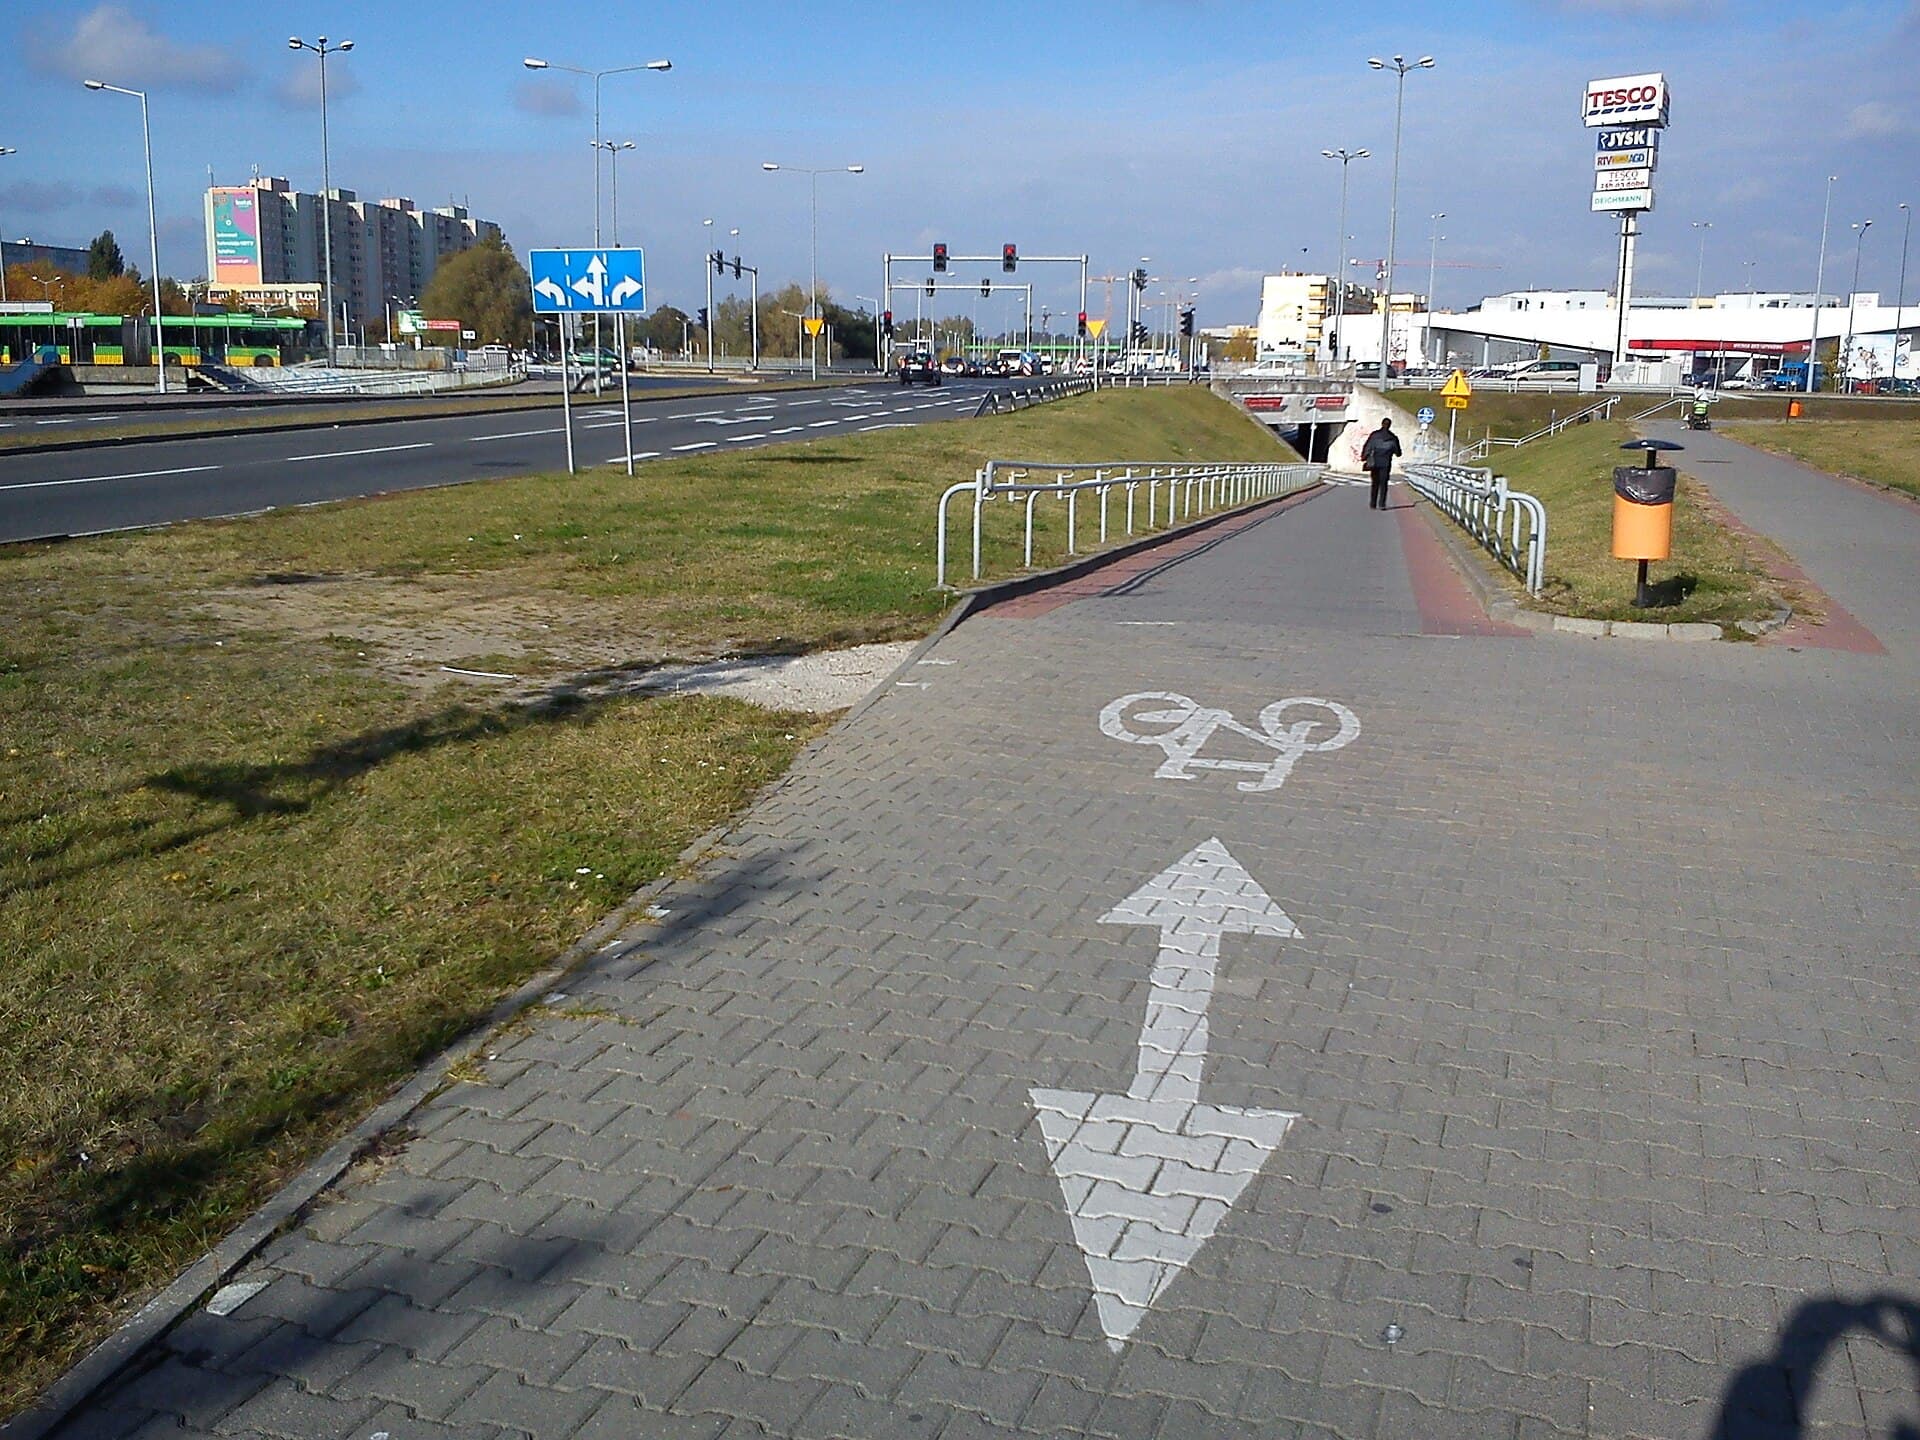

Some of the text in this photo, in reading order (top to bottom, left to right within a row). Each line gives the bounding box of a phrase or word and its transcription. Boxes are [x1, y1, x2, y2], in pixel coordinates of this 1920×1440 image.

[1588, 86, 1657, 107] TESCO
[1607, 130, 1646, 147] JYSK
[1609, 170, 1639, 179] TESCO
[1595, 195, 1642, 205] DEICHMANN
